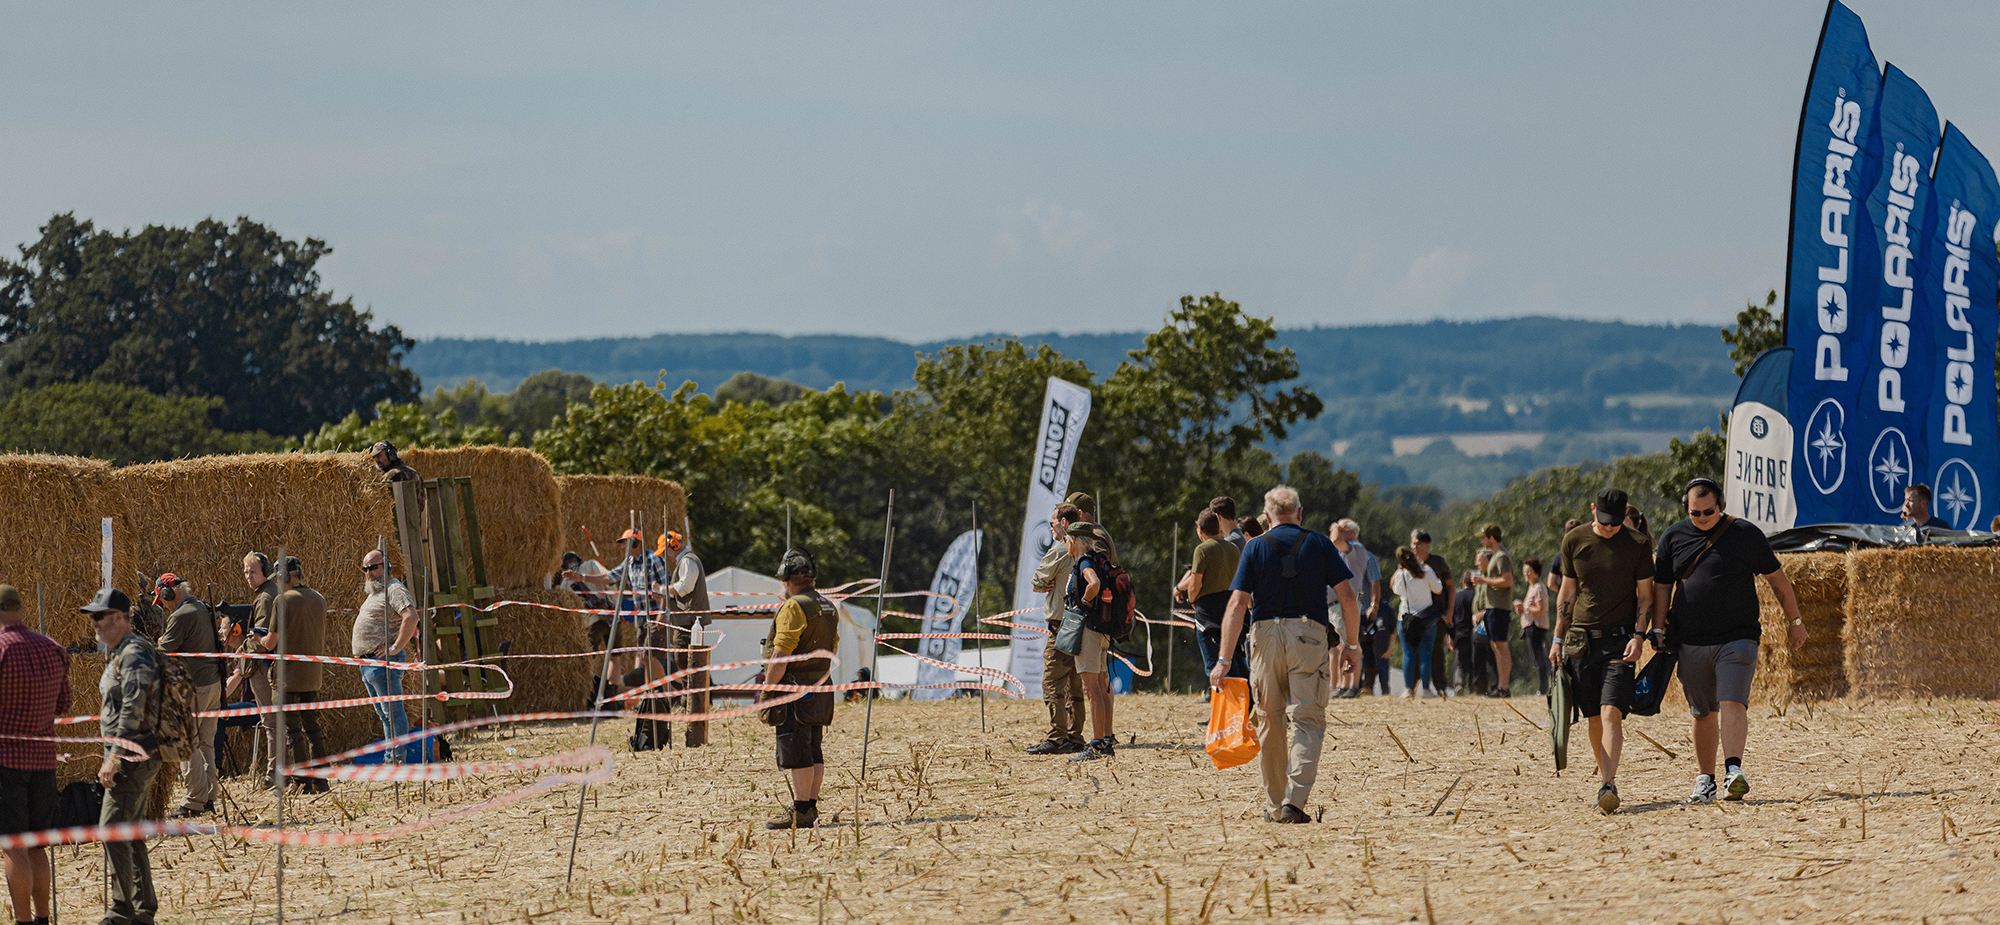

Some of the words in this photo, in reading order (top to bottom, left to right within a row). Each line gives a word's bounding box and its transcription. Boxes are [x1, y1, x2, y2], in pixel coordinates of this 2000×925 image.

[1815, 97, 1861, 382] POLARIS
[1878, 150, 1920, 413] POLARIS
[1943, 204, 1977, 446] POLARIS
[1041, 406, 1066, 485] SONIC
[1205, 724, 1240, 745] UNTEX
